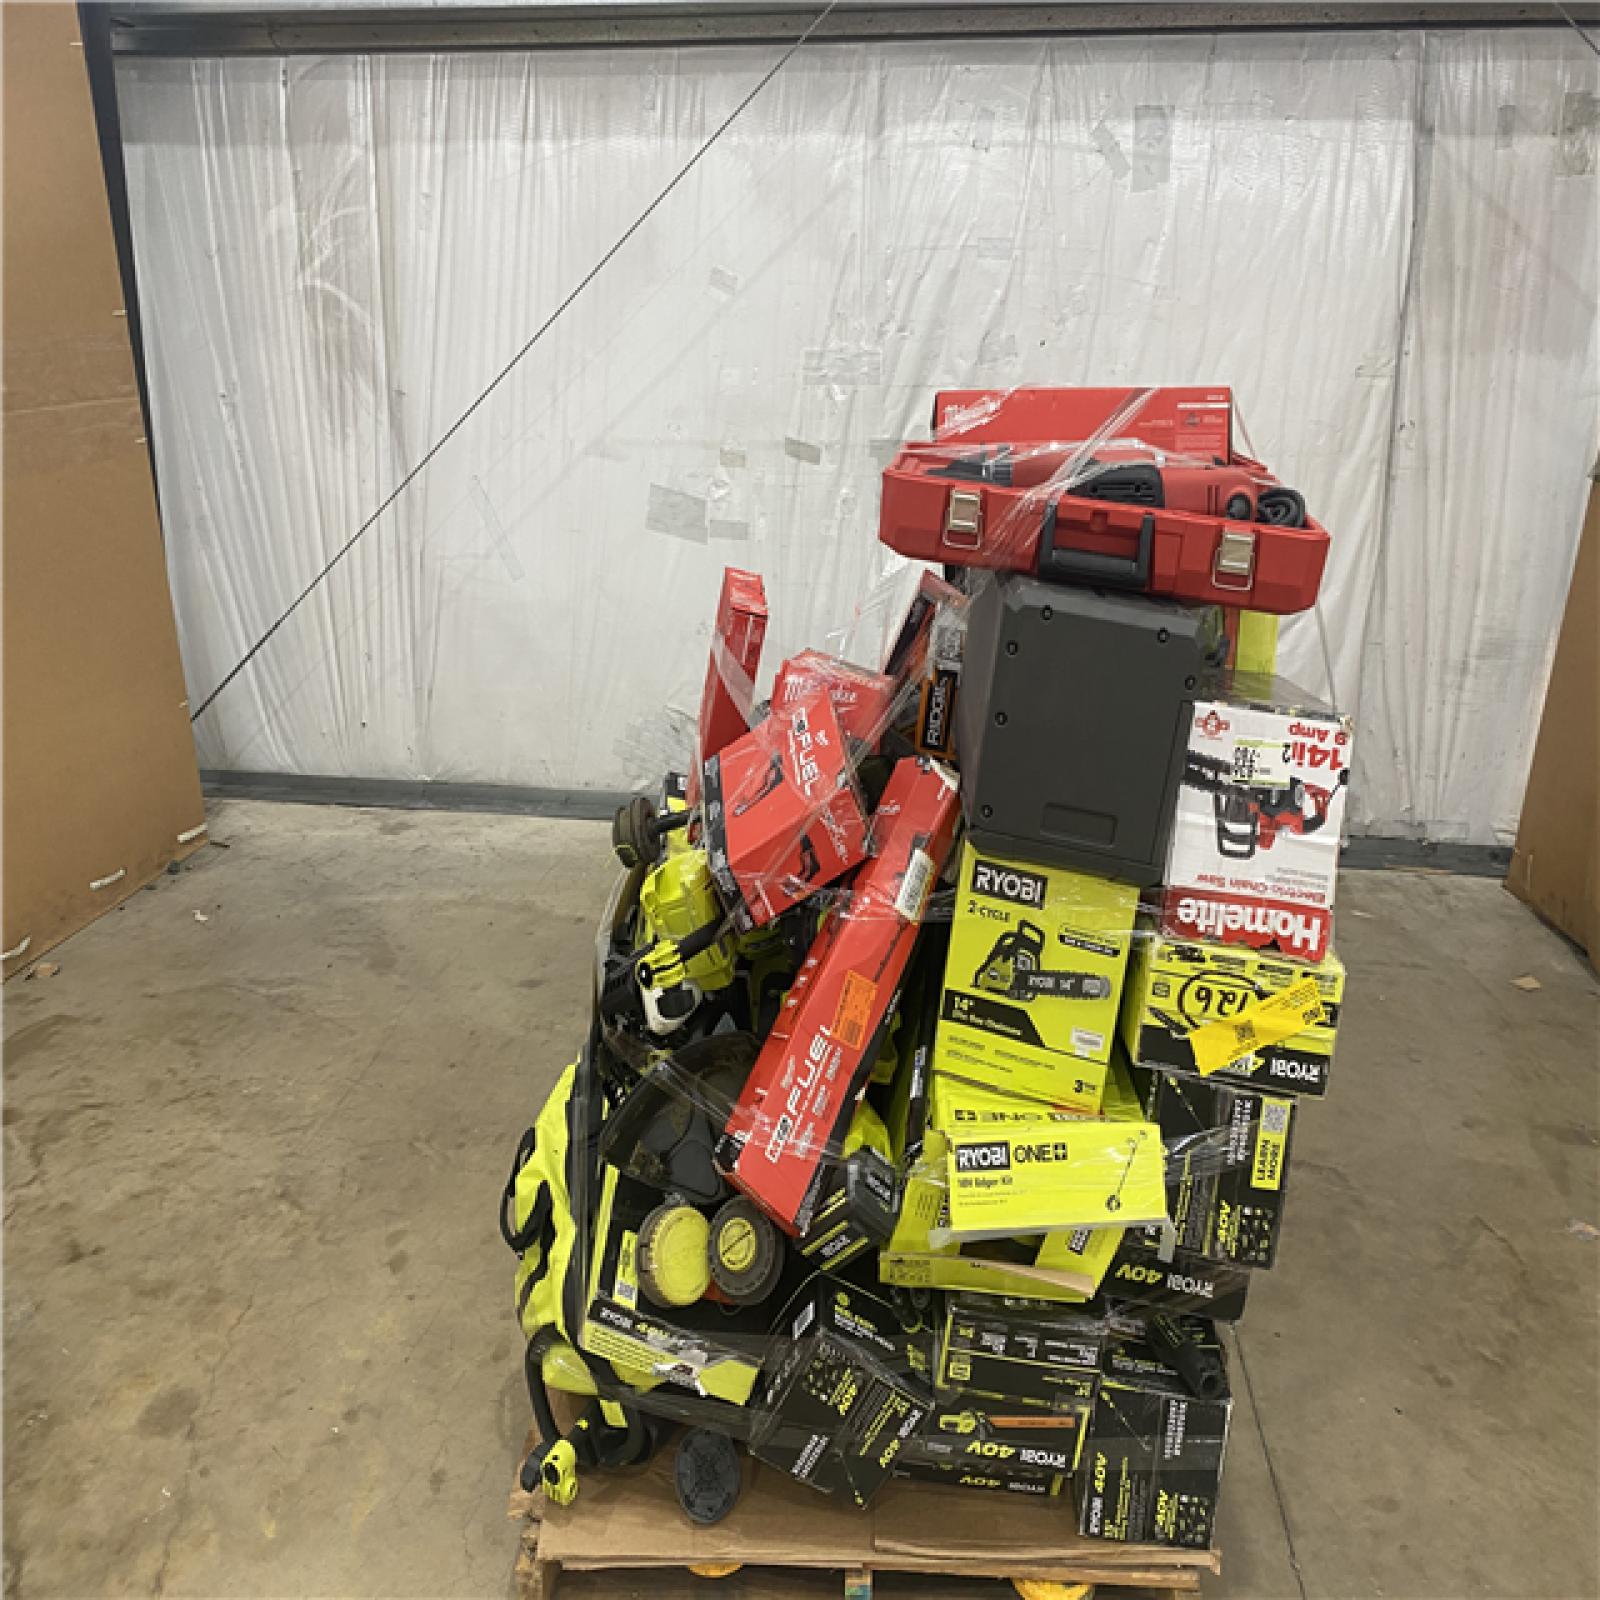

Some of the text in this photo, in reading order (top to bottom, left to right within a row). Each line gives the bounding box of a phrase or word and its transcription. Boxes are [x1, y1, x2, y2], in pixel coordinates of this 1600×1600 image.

[1288, 722, 1330, 743] Amp
[976, 866, 1042, 903] RYOBI
[1177, 897, 1321, 951] Homelite
[1269, 1057, 1321, 1083] RYOBI
[957, 1145, 1006, 1169] RYOBI
[1114, 1264, 1216, 1299] RYOBI 40V
[966, 1440, 1066, 1468] RYOBI 40V
